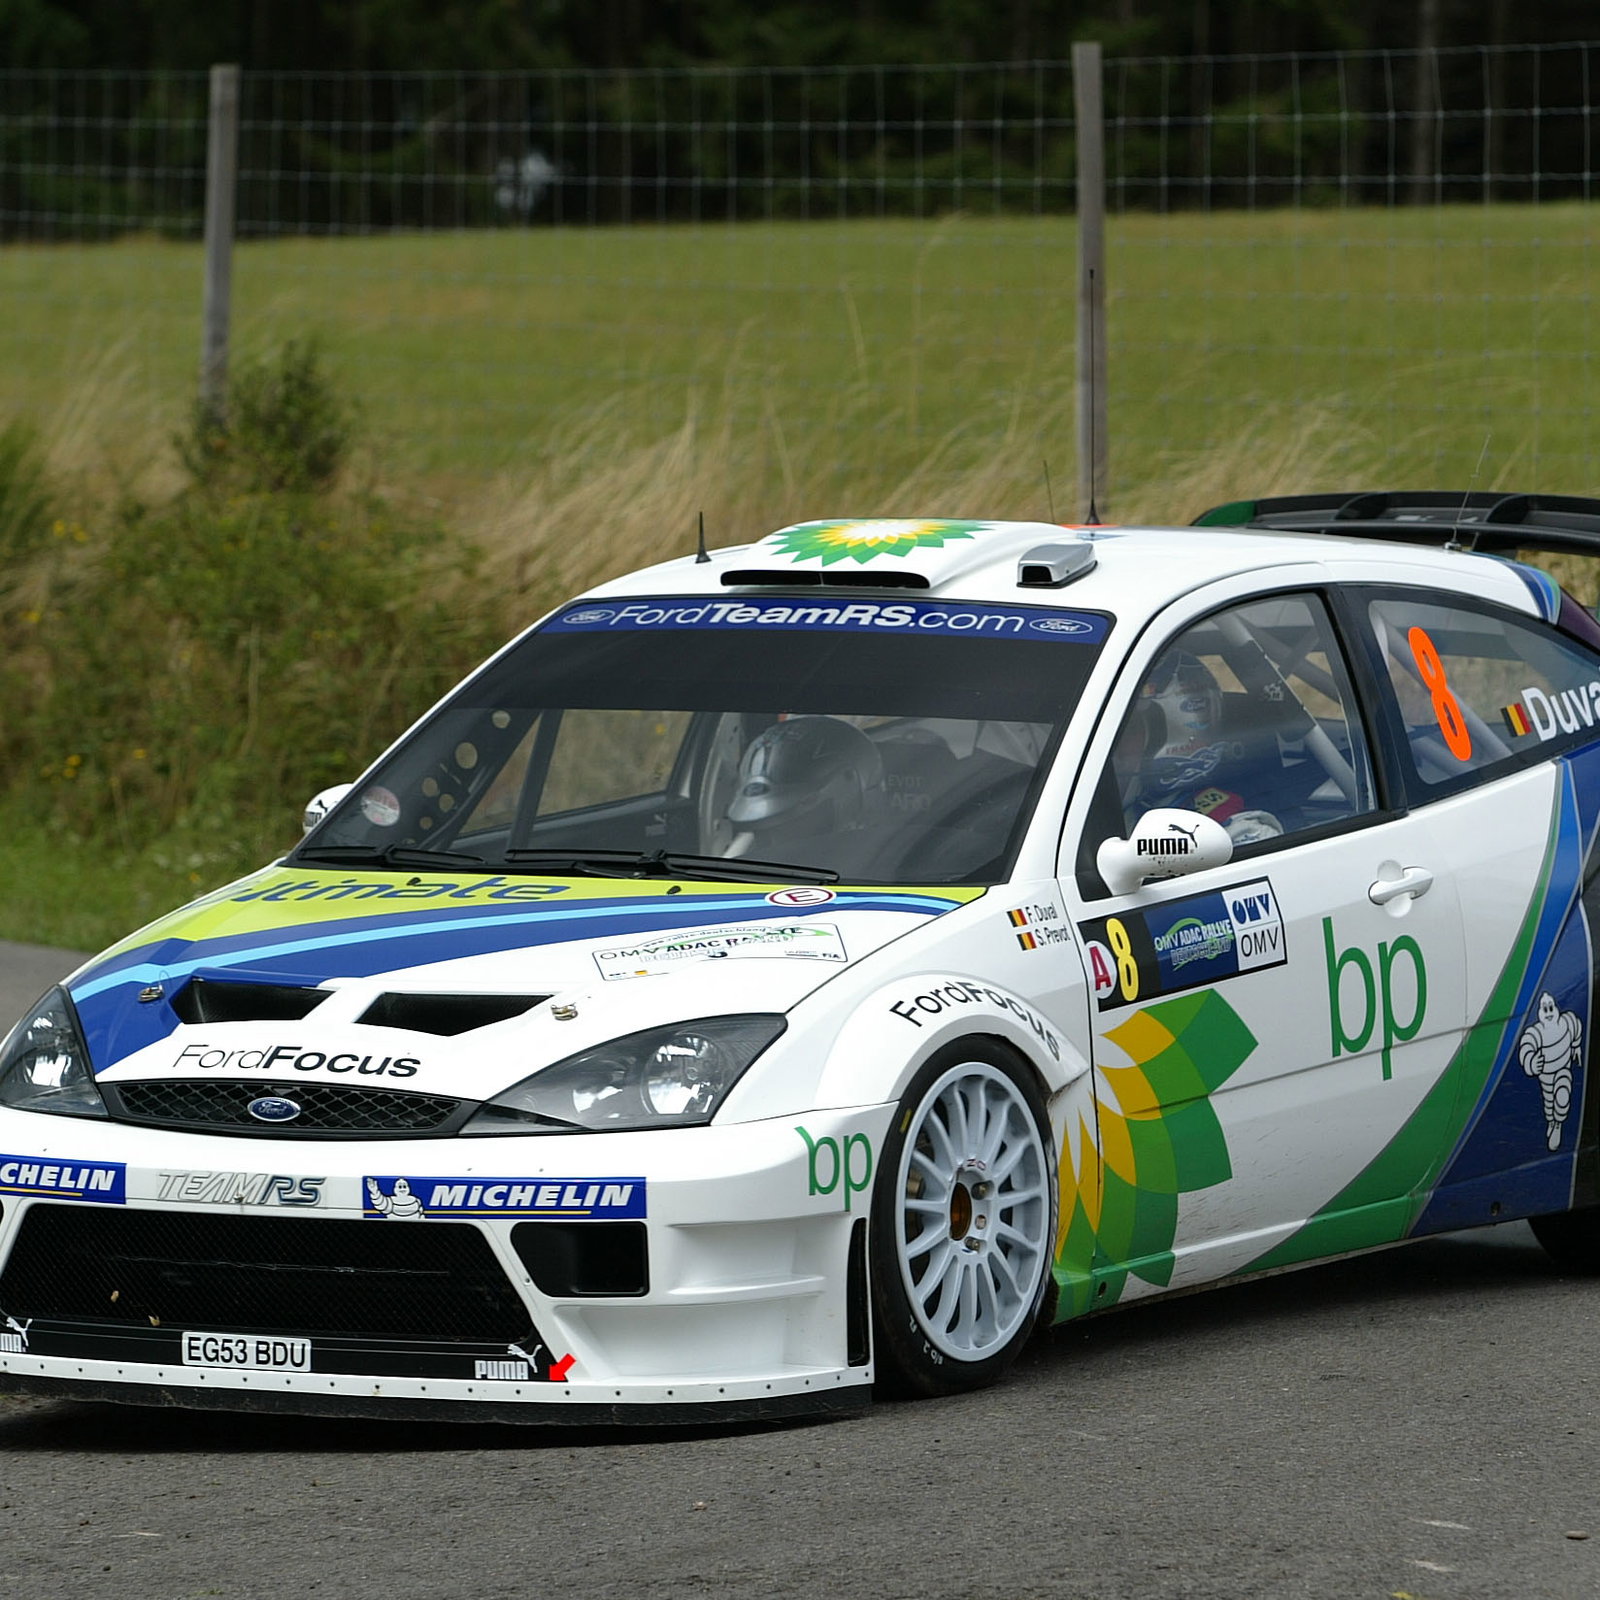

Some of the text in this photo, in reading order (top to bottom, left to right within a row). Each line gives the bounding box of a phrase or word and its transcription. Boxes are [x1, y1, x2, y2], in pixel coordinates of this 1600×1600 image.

[609, 603, 1025, 633] FordTeamRS.com
[1038, 619, 1085, 632] Ford
[1408, 626, 1471, 761] 8
[1137, 838, 1188, 855] PUMA
[786, 890, 822, 903] E
[600, 946, 660, 960] OMV
[666, 940, 721, 952] ADAC
[1154, 919, 1233, 951] OMV ADAC RALLYE
[1240, 927, 1279, 957] OMV
[1089, 946, 1112, 991] A
[1106, 917, 1139, 1001] 8
[1323, 916, 1427, 1080] bp
[889, 981, 1060, 1061] FordFocus
[173, 1044, 421, 1077] FordFocus
[0, 1163, 116, 1191] CHELIN
[794, 1126, 873, 1212] bp
[158, 1171, 327, 1206] TEAMRS
[429, 1184, 633, 1207] MICHELIN
[188, 1337, 306, 1368] EG53 BDU
[475, 1360, 528, 1380] PUMA
